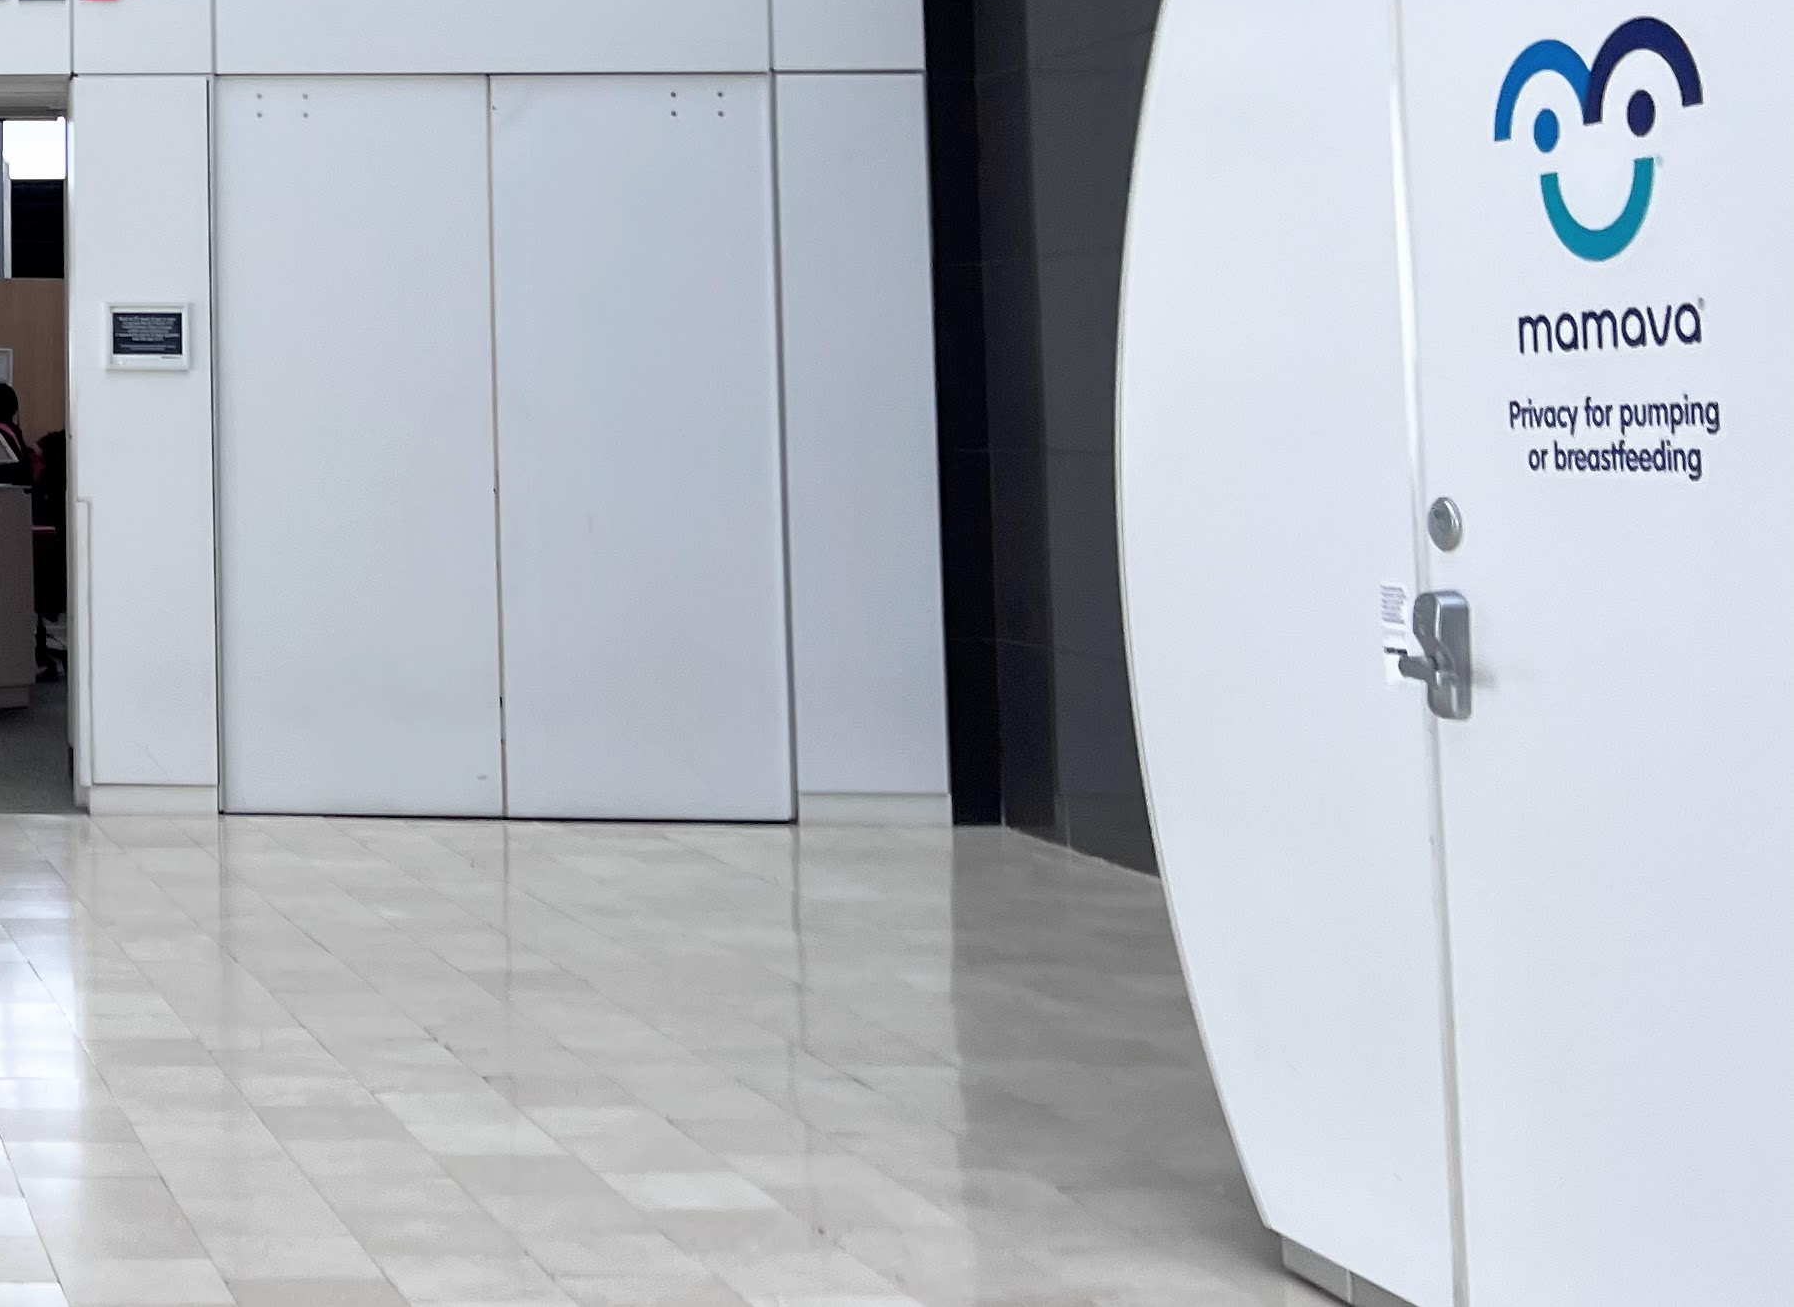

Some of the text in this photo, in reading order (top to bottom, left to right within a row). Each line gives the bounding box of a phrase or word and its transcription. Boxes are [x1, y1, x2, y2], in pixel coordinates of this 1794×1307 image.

[1518, 302, 1703, 354] mamava
[1509, 393, 1720, 436] Privacy for pumping
[1528, 439, 1702, 481] or breastfeeding
